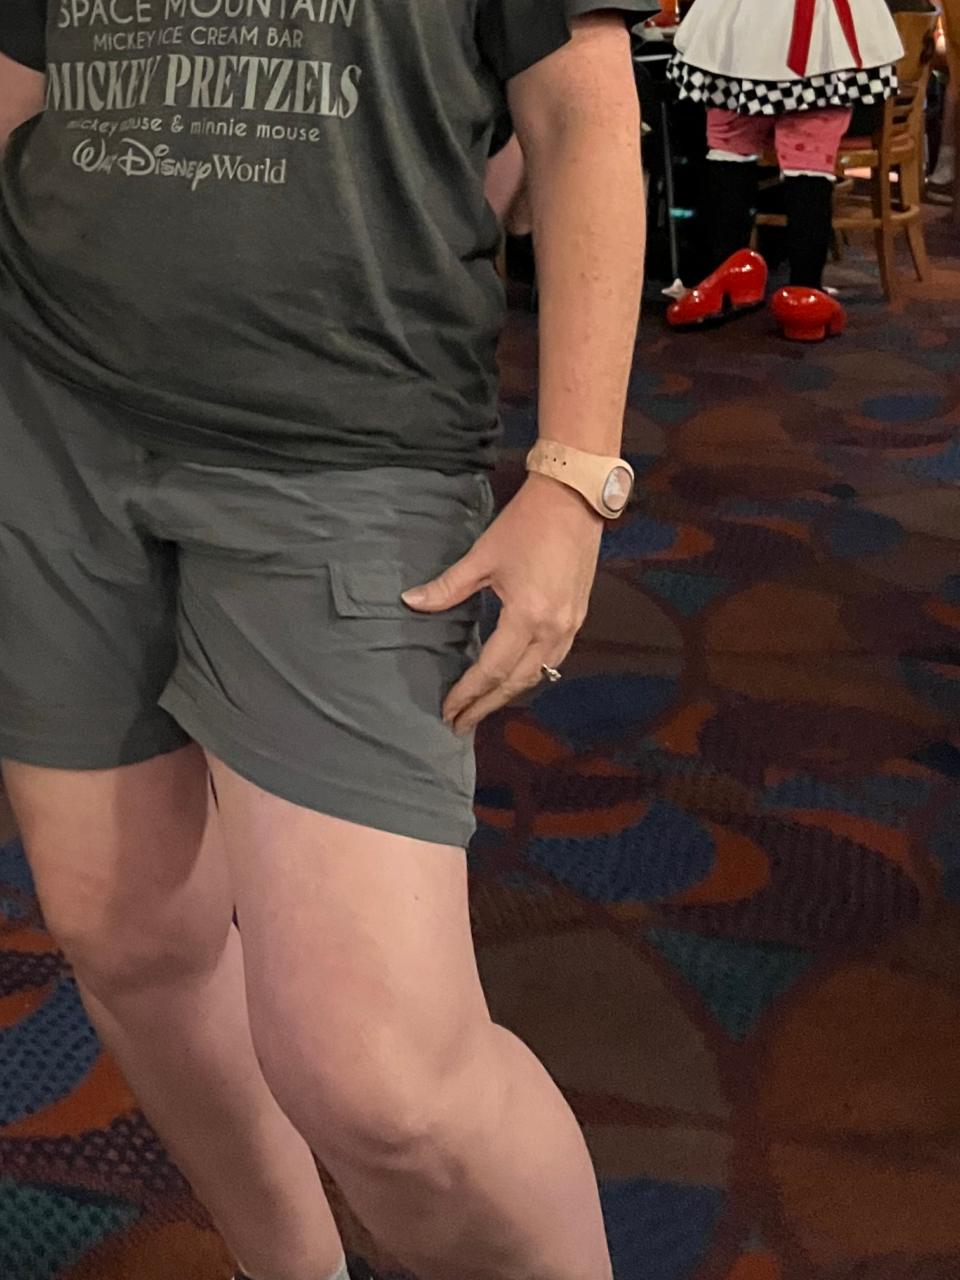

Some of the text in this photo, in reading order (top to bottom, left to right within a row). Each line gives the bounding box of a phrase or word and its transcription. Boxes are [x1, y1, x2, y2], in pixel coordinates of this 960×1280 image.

[93, 25, 304, 52] MICKEY ICE CREAM BAR
[44, 53, 363, 119] MICKEY PRETZELS
[65, 113, 321, 142] ckey use & minnie mouse
[72, 137, 119, 175] Wat
[212, 153, 288, 185] World
